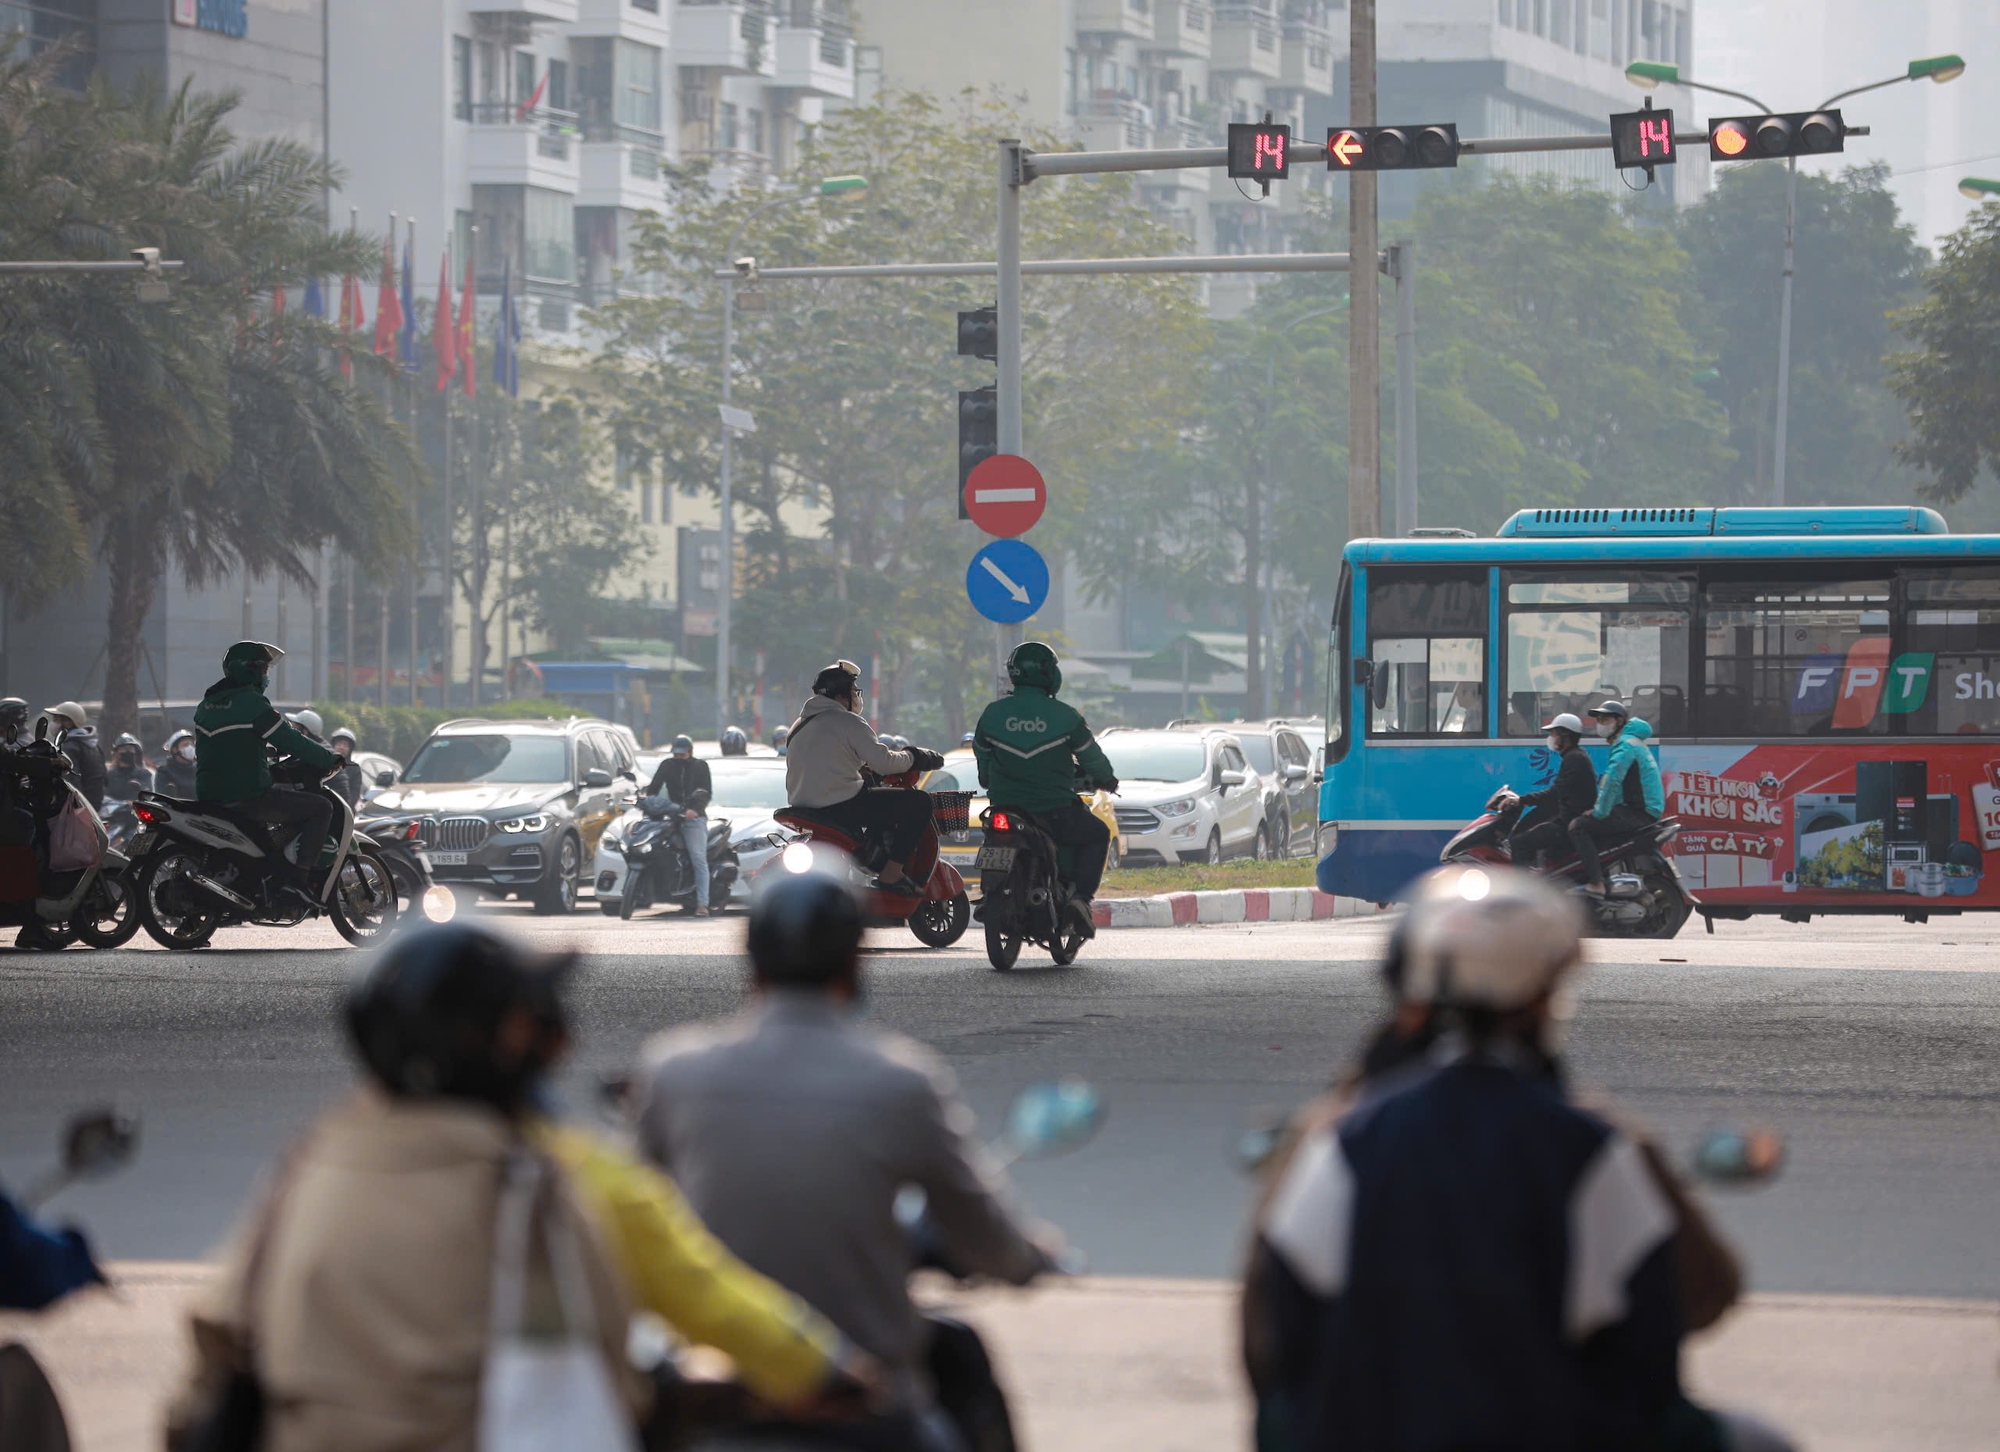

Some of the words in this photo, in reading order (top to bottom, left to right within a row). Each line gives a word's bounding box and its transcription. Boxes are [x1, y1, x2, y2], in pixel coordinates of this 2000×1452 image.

[1254, 133, 1284, 170] 14
[1639, 118, 1670, 157] 14
[1798, 667, 1927, 699] FPT
[1955, 672, 2000, 700] Sh
[1005, 716, 1048, 733] Grab
[1710, 832, 1738, 851] CẢ
[1742, 836, 1768, 855] TỶ
